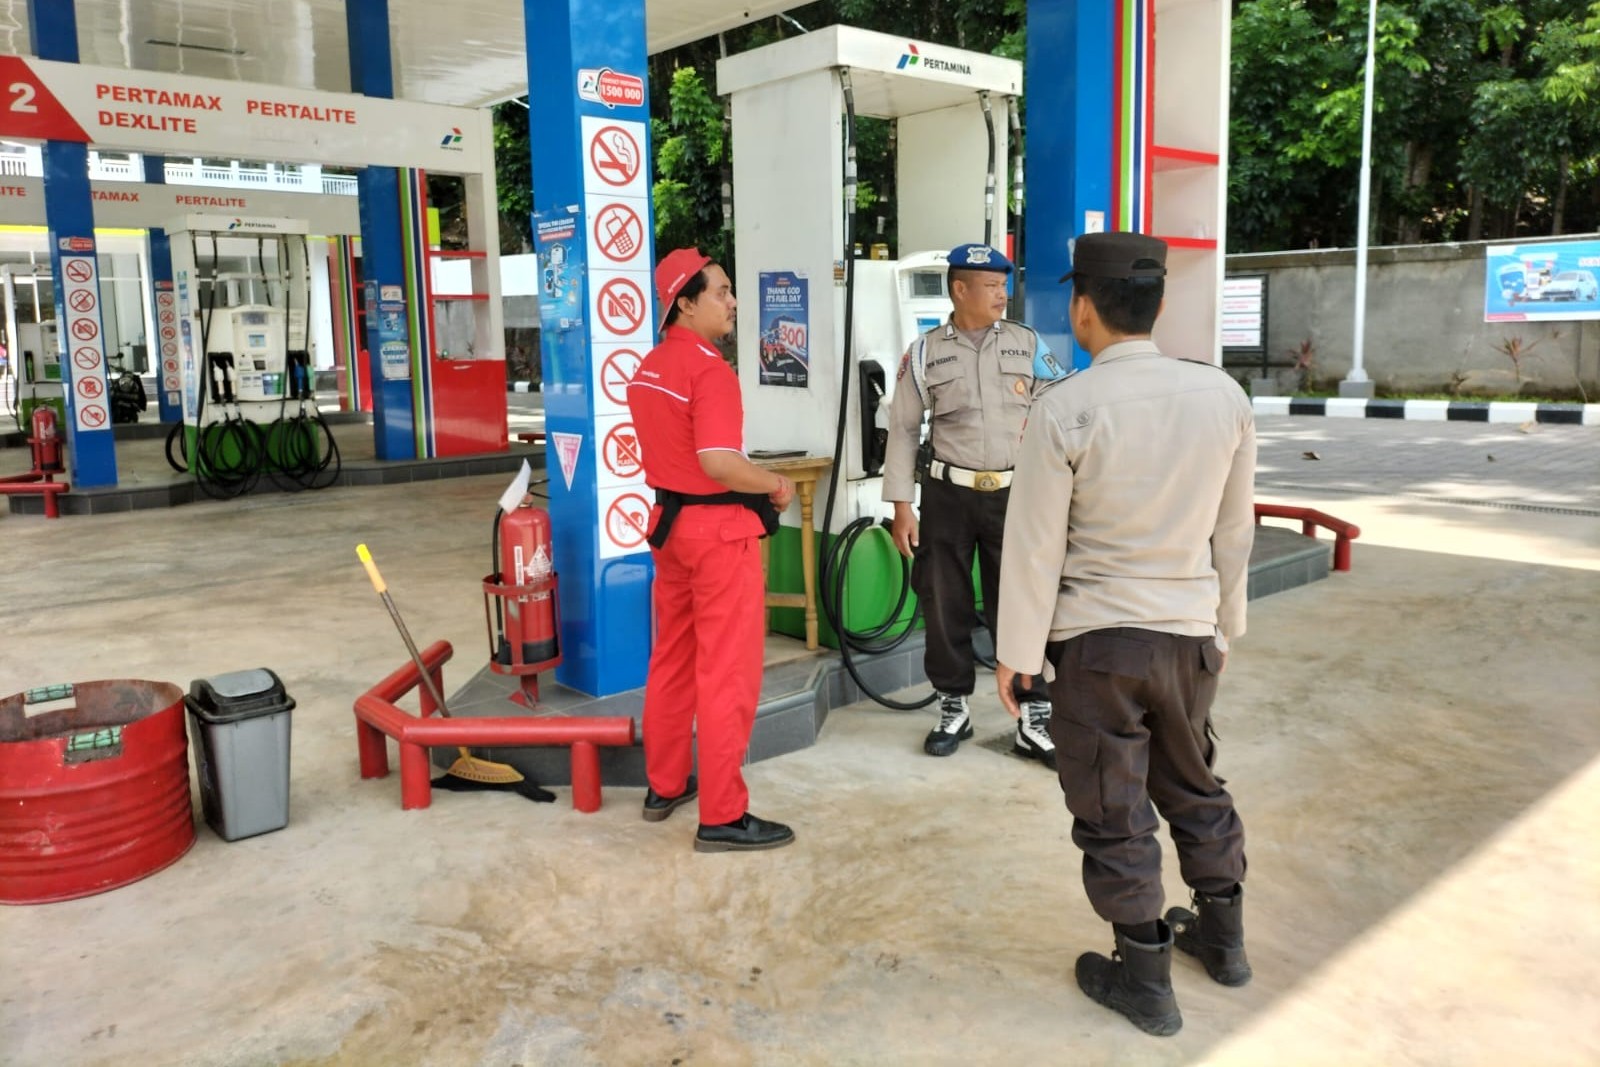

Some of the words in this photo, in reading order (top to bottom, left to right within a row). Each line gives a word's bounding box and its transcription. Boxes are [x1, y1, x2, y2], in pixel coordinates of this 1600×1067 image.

[923, 57, 972, 75] PERTAMINA
[8, 82, 38, 113] 2
[601, 85, 624, 98] 1500
[624, 88, 641, 100] 000
[96, 84, 223, 112] PERTAMAX
[246, 99, 357, 124] PERTALITE
[98, 111, 197, 133] DEXLITE
[0, 186, 26, 197] ITE
[91, 191, 139, 202] TAMAX
[175, 195, 246, 208] PERTALITE
